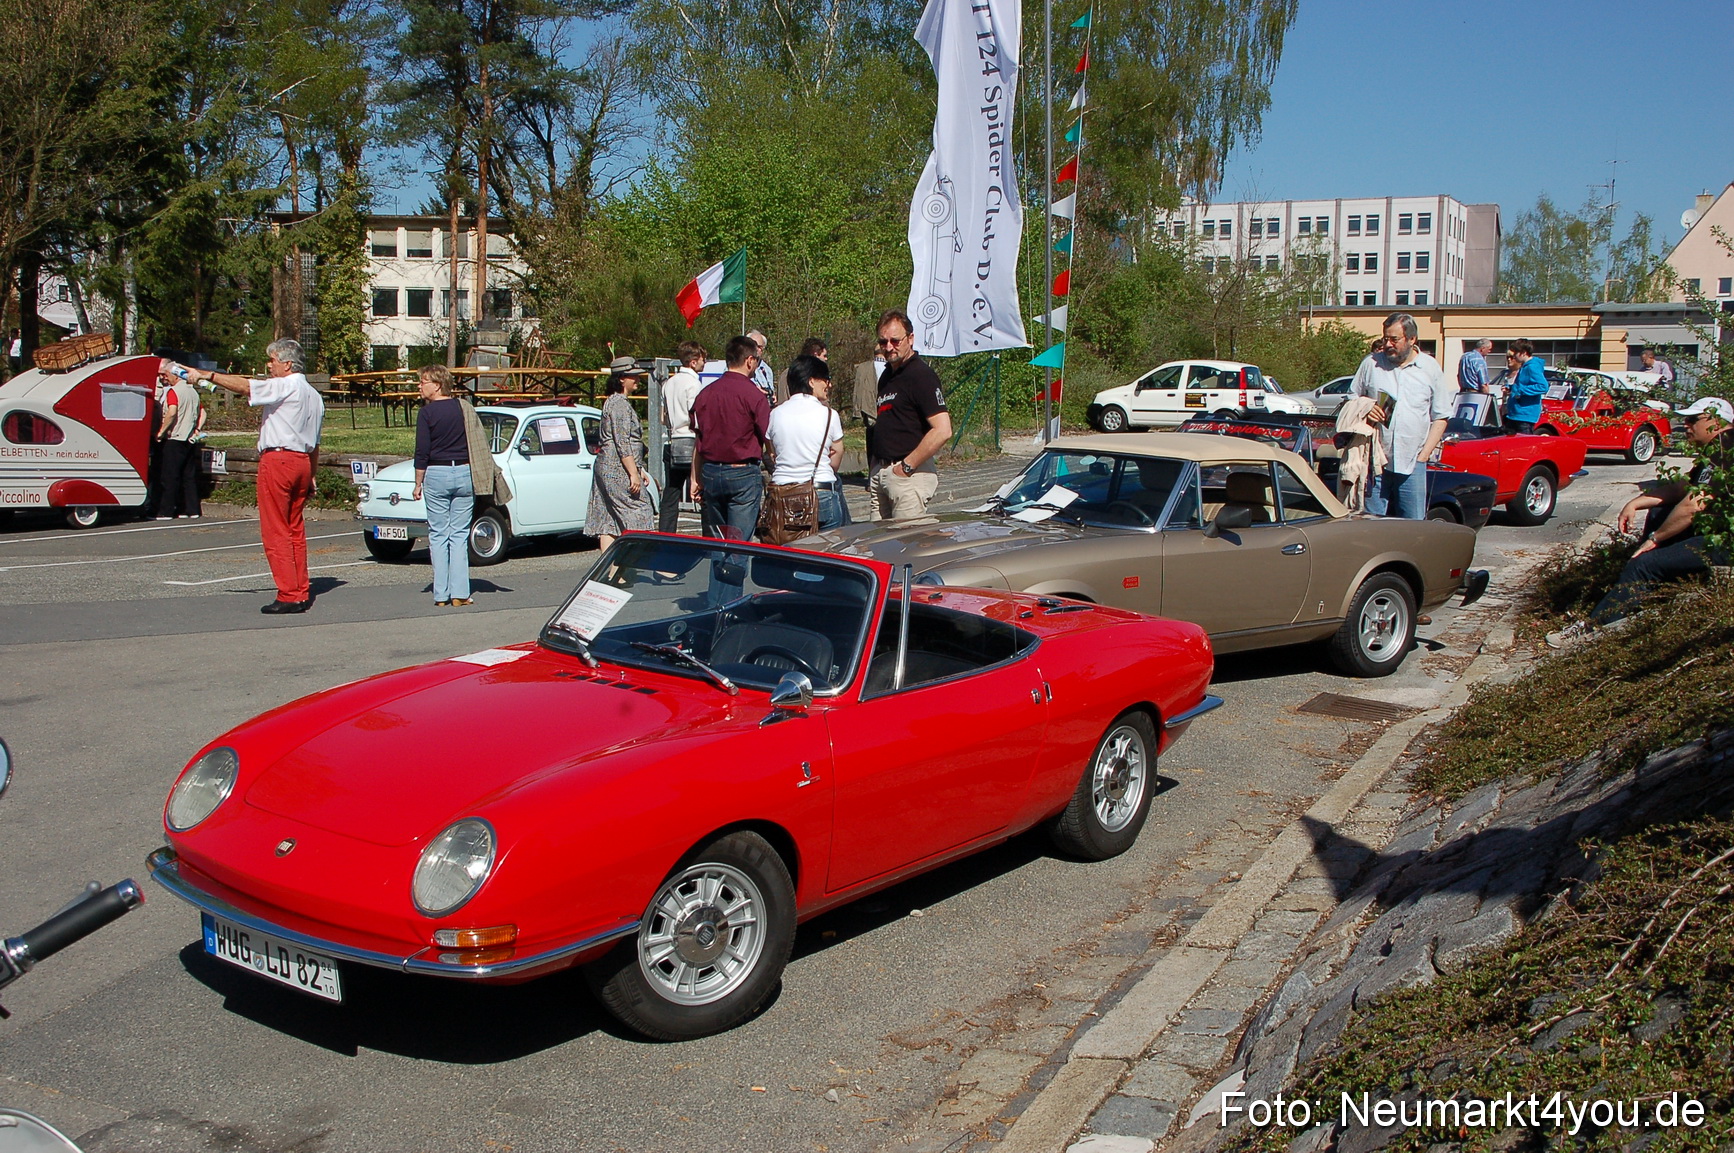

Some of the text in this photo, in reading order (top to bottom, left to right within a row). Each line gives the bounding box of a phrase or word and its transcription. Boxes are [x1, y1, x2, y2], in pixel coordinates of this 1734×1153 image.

[976, 30, 1001, 76] 124
[981, 85, 1004, 177] Spider
[982, 185, 1002, 251] Club
[975, 257, 991, 290] D.
[973, 298, 992, 346] e.V.
[0, 447, 48, 457] ELBETTEN
[56, 450, 72, 458] nein
[74, 450, 100, 459] danke!
[354, 463, 361, 473] P
[363, 463, 375, 479] 41
[0, 489, 41, 503] iccolino
[216, 922, 323, 991] WUG LD 82
[324, 984, 335, 996] 10
